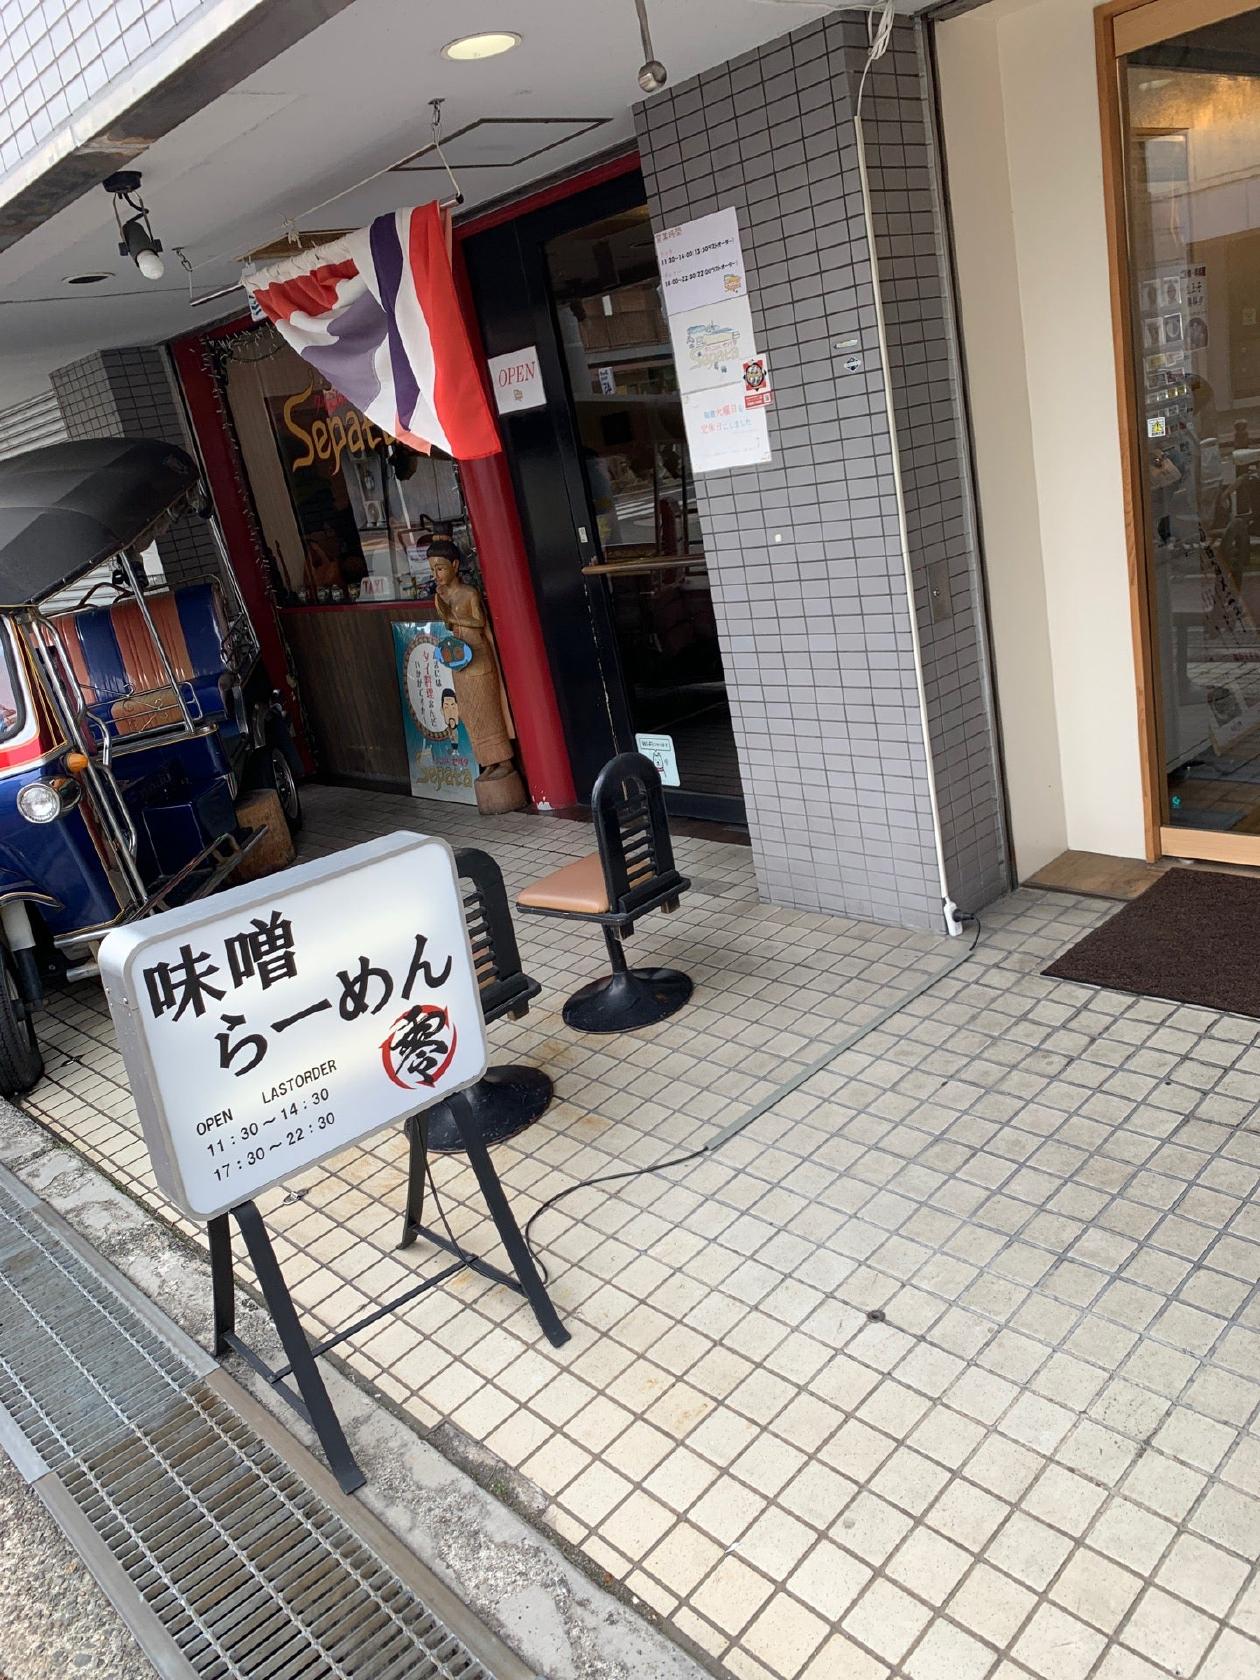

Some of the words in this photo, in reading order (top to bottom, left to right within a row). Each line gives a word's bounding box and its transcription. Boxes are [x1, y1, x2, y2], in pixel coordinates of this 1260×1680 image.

[498, 361, 536, 388] OPEN
[143, 910, 298, 1022] 味噌
[213, 934, 453, 1077] らーめん
[196, 1108, 233, 1137] OPEN
[261, 1059, 337, 1104] LASTORDER
